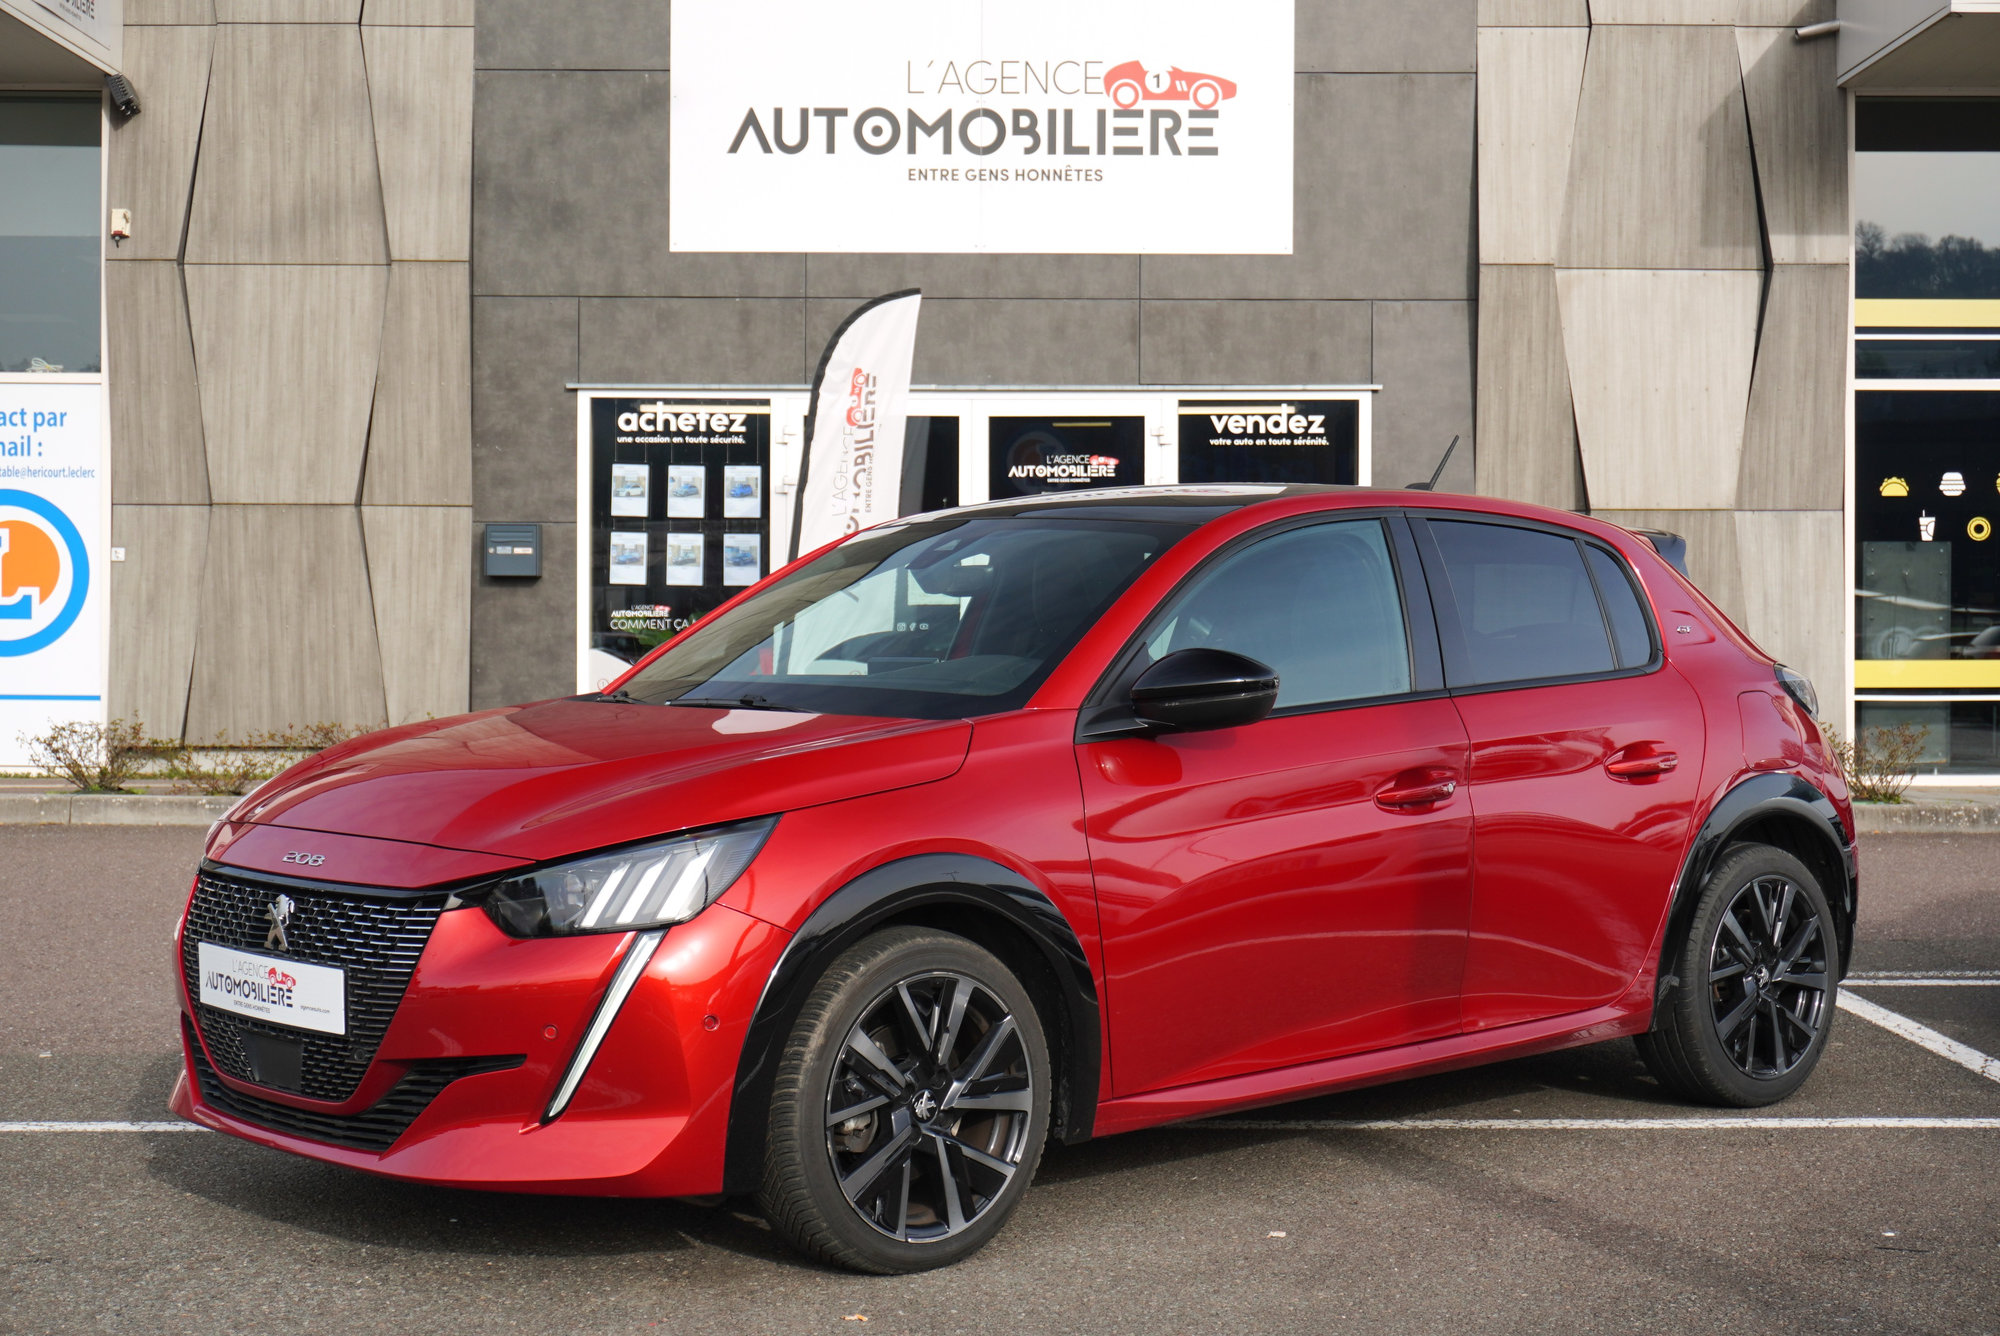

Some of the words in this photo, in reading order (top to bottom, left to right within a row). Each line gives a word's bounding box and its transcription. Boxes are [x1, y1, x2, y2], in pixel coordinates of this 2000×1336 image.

[907, 60, 1103, 95] L'AGENCE
[908, 168, 960, 181] ENTRE
[966, 168, 1009, 181] GENS
[1015, 164, 1103, 181] HONNÊTES
[33, 411, 67, 432] par
[617, 401, 747, 432] achetez
[1210, 403, 1325, 434] vendez
[617, 435, 633, 443] une
[635, 434, 670, 443] occasion
[686, 434, 708, 443] toute
[710, 433, 746, 444] sécurité.
[1294, 436, 1329, 446] sérénité.
[1046, 455, 1090, 464] L'AGENCE
[610, 619, 671, 630] COMMENT
[282, 851, 325, 867] 208
[232, 959, 270, 980] L'AGENCE
